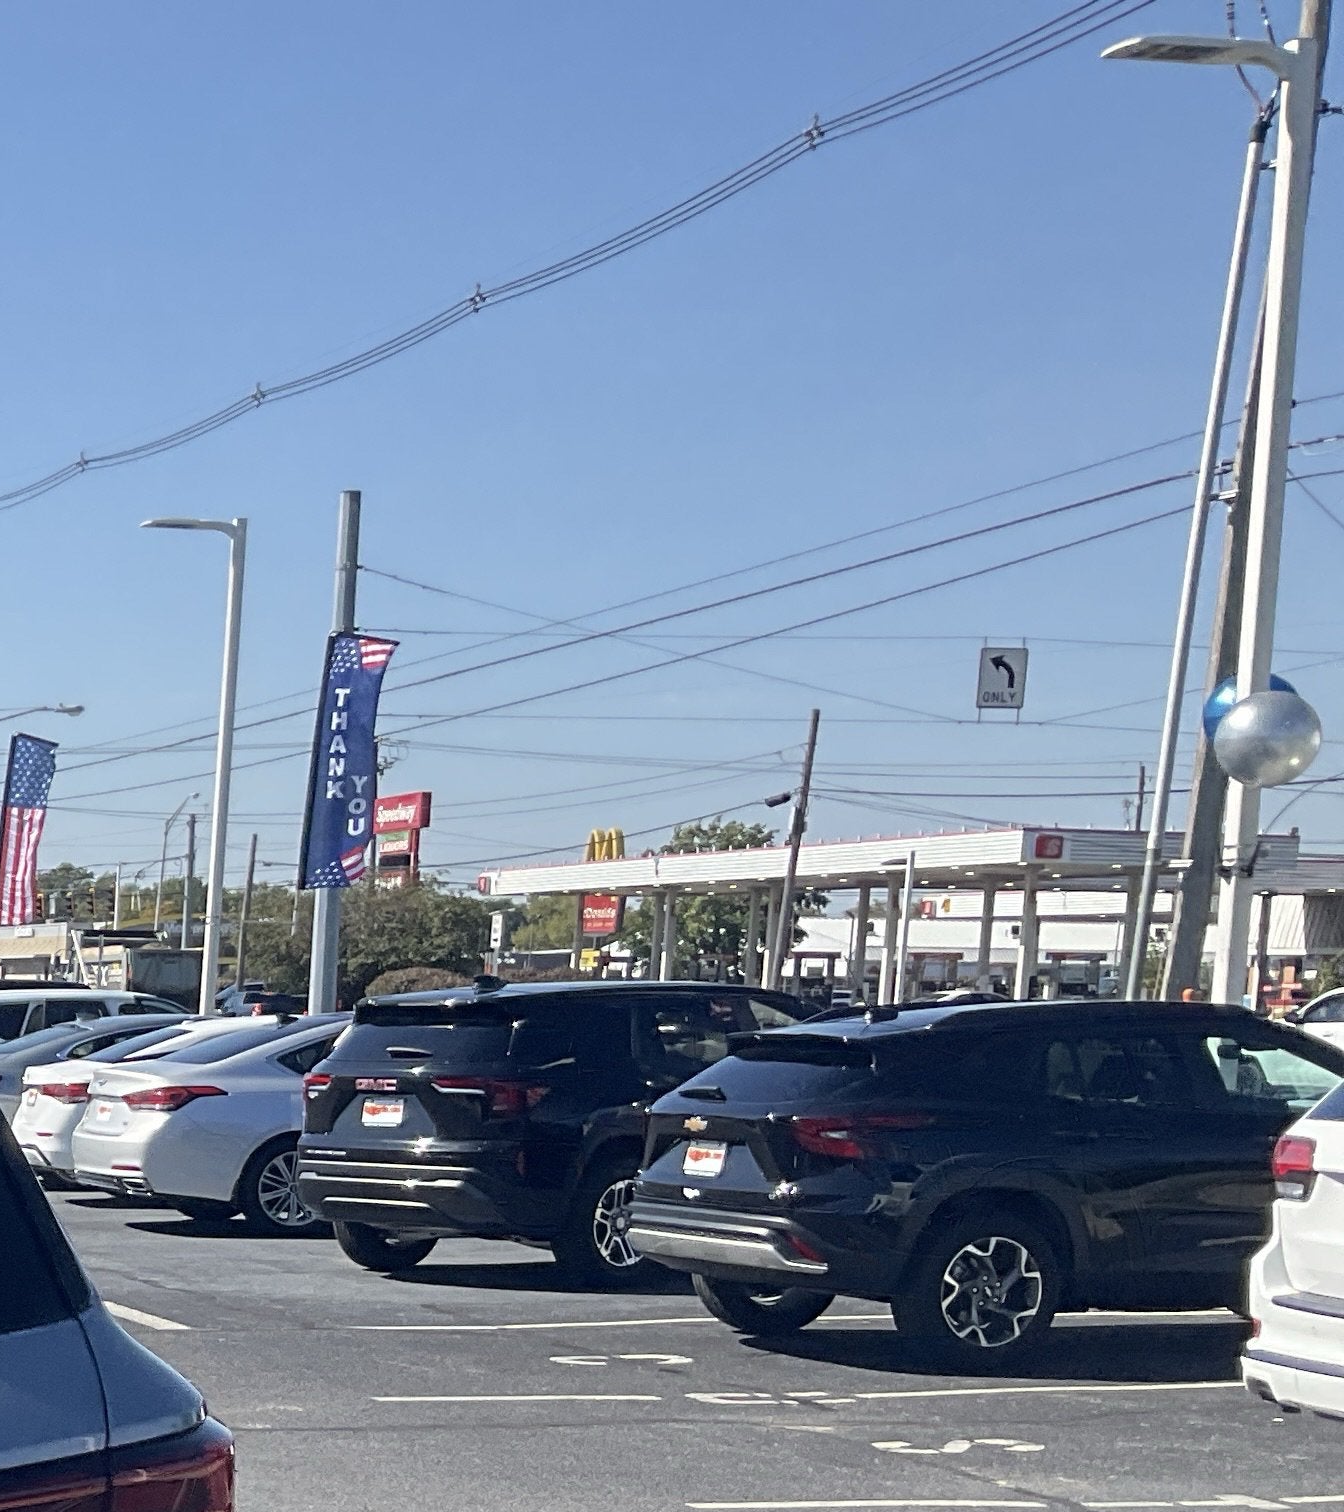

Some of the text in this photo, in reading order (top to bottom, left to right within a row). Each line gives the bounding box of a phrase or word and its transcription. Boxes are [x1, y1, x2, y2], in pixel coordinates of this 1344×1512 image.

[982, 691, 1018, 703] ONLY
[326, 687, 351, 799] THANK
[347, 775, 368, 836] YOU
